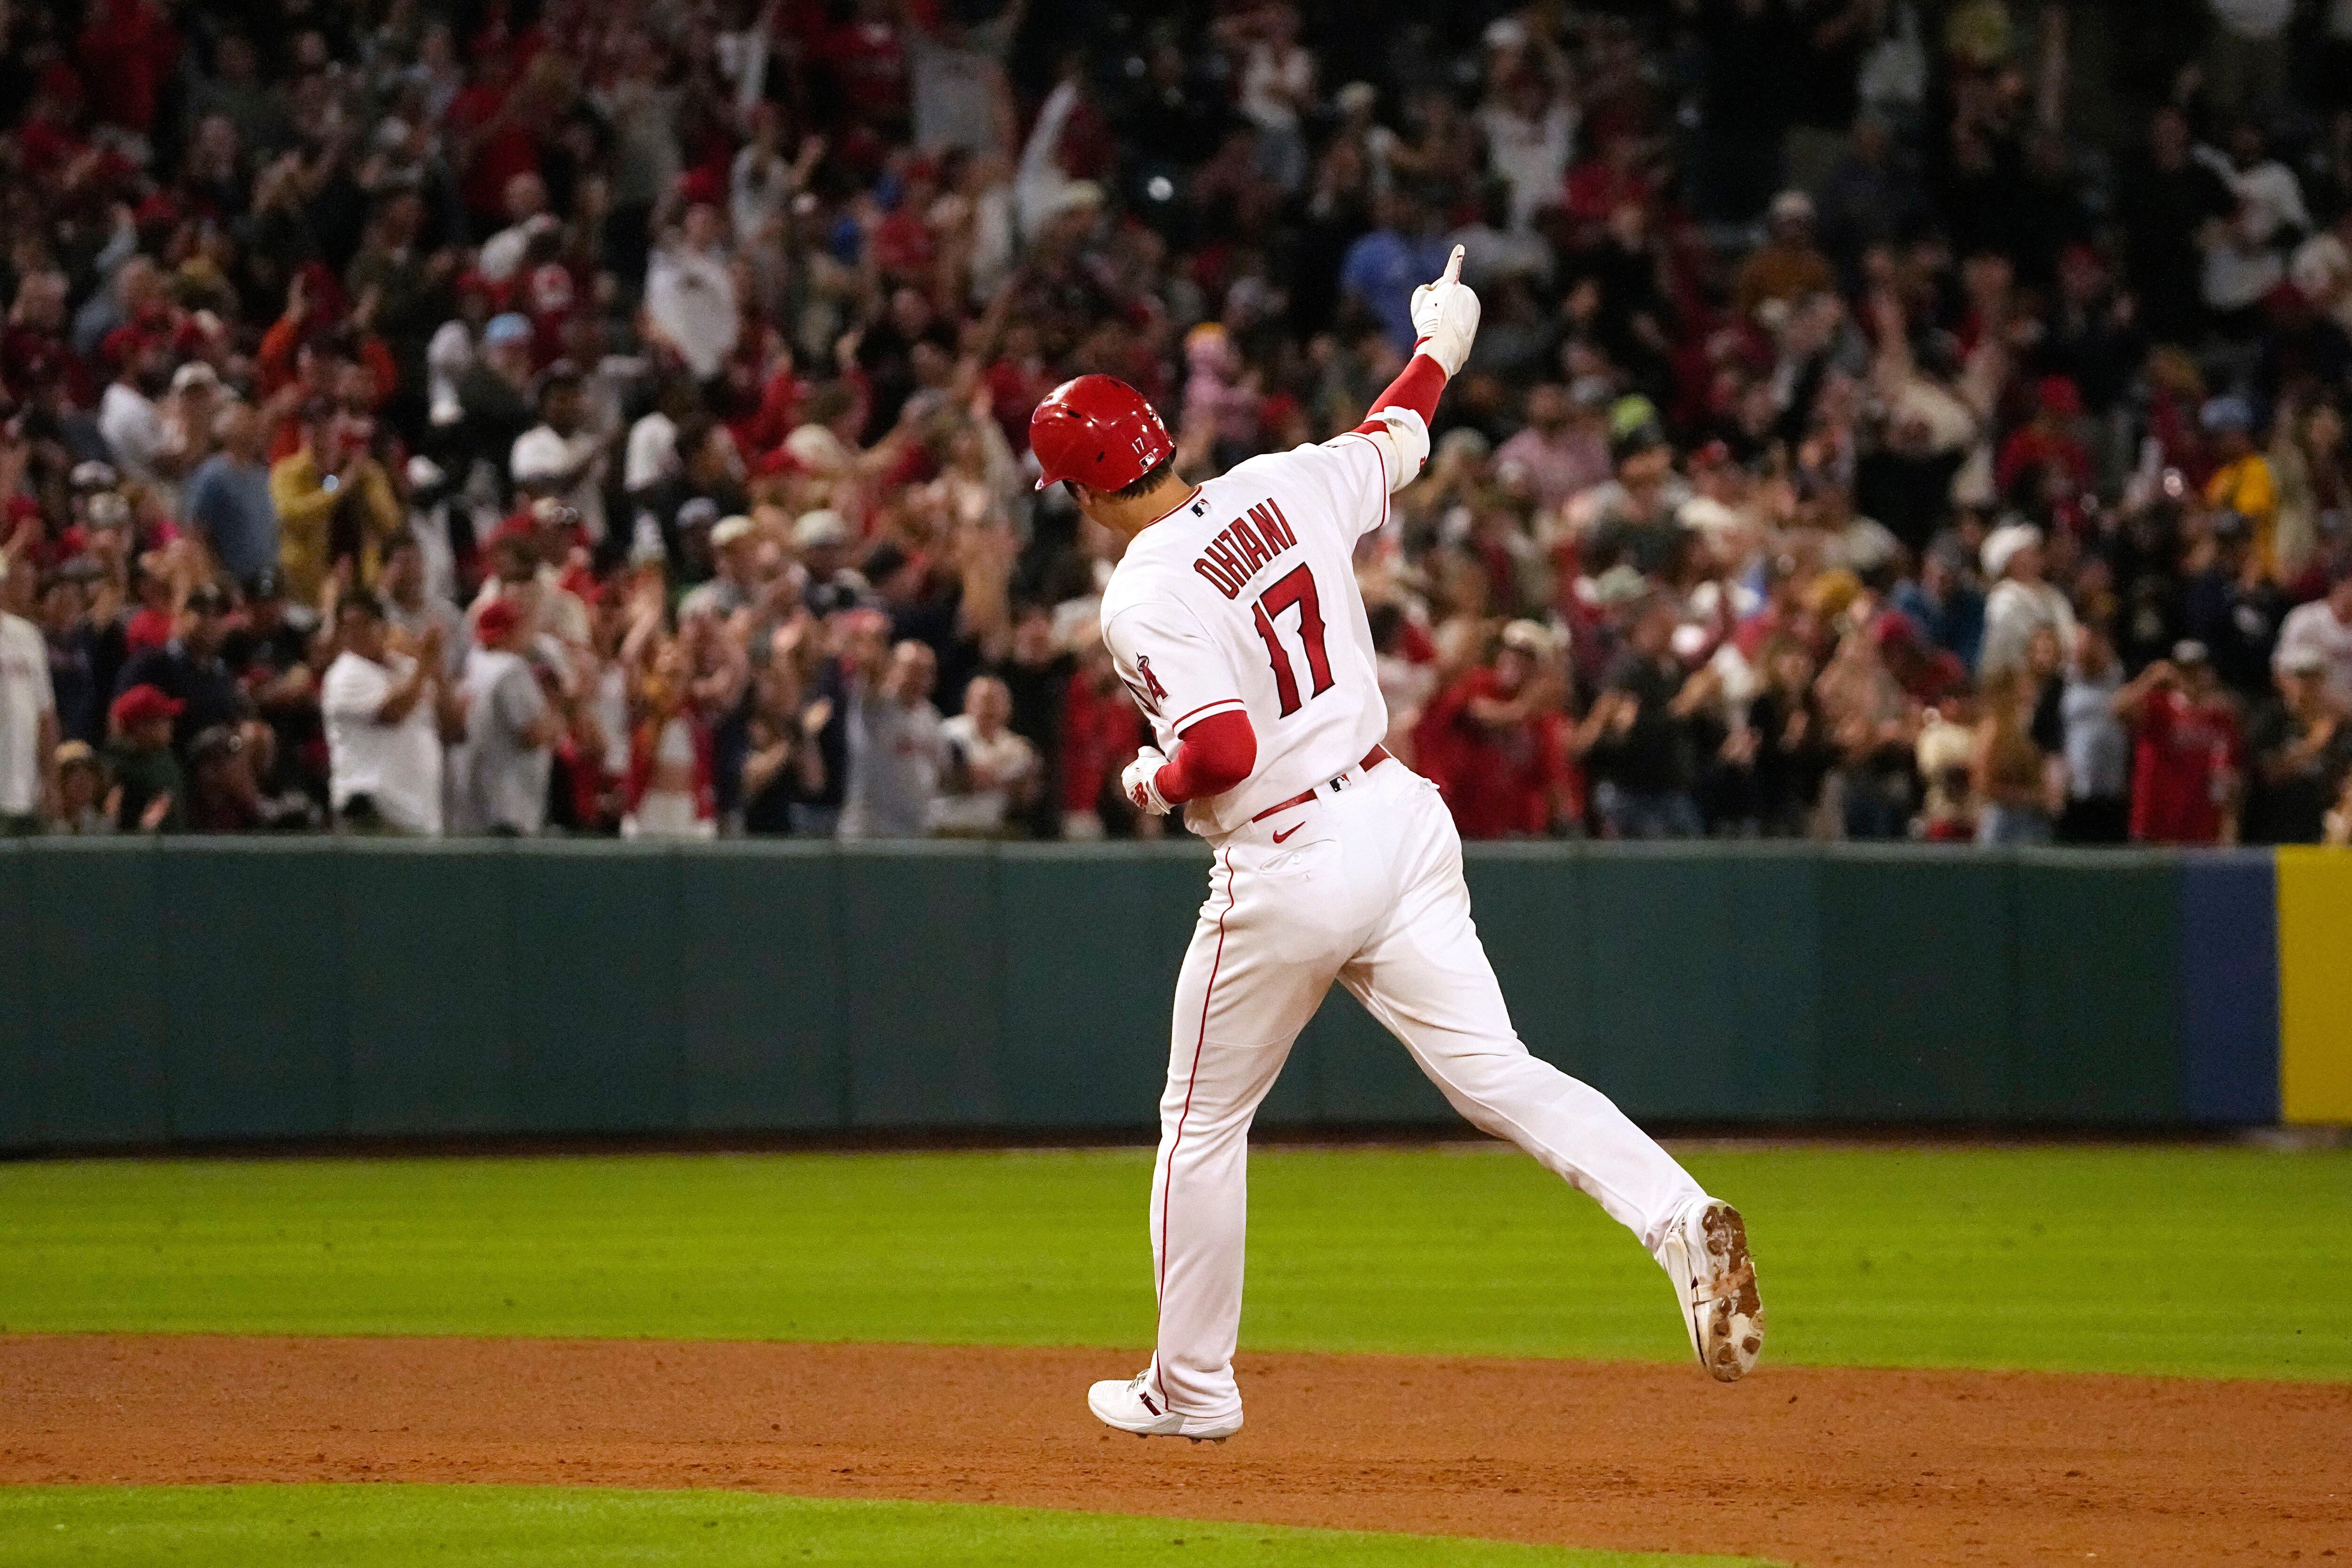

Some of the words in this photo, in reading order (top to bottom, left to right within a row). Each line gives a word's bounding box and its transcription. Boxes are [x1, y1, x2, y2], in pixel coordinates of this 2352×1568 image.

[1131, 437, 1144, 454] 17
[1193, 497, 1297, 600] OHTANI
[1251, 562, 1335, 719] 17
